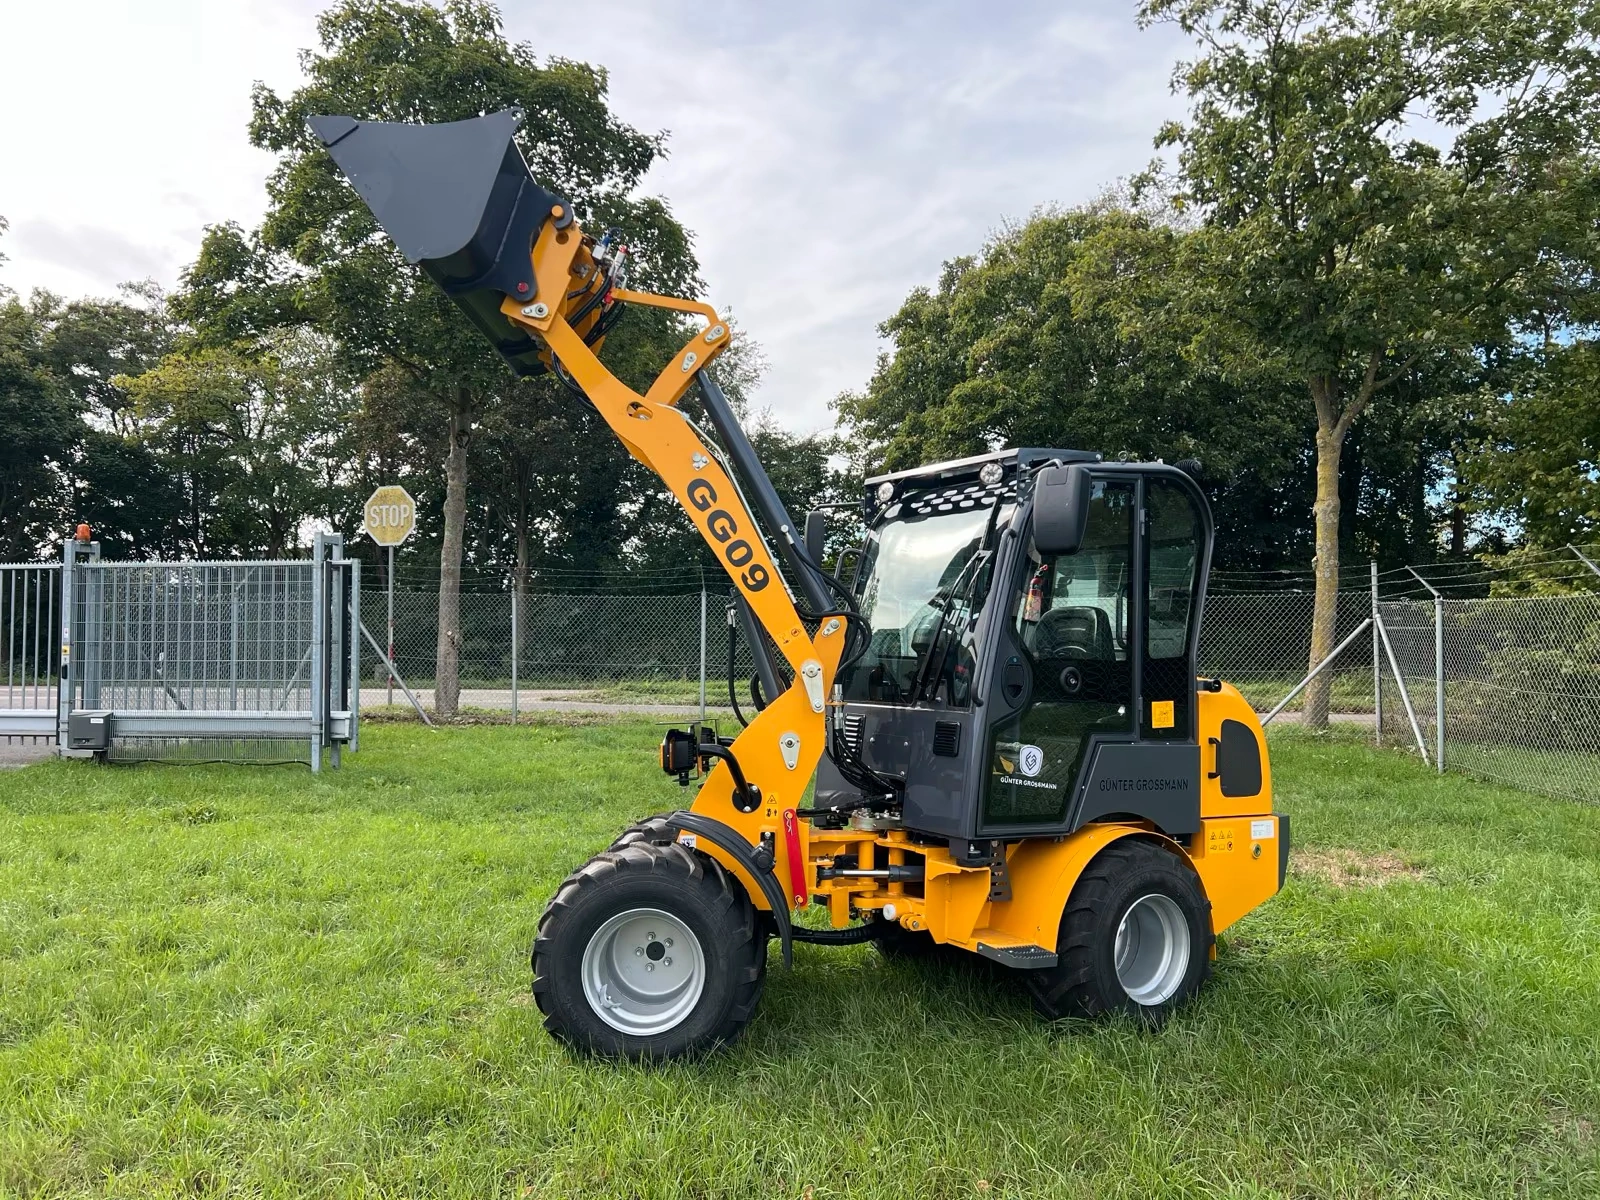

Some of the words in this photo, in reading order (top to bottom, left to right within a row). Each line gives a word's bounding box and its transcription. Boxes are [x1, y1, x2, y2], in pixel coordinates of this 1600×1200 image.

[370, 504, 410, 528] STOP
[687, 478, 770, 592] GG09
[1000, 775, 1023, 785] GÜNTER
[1023, 779, 1058, 790] GROSSMANN
[1100, 777, 1134, 792] GÜNTER
[1136, 779, 1189, 791] GROSSMANN
